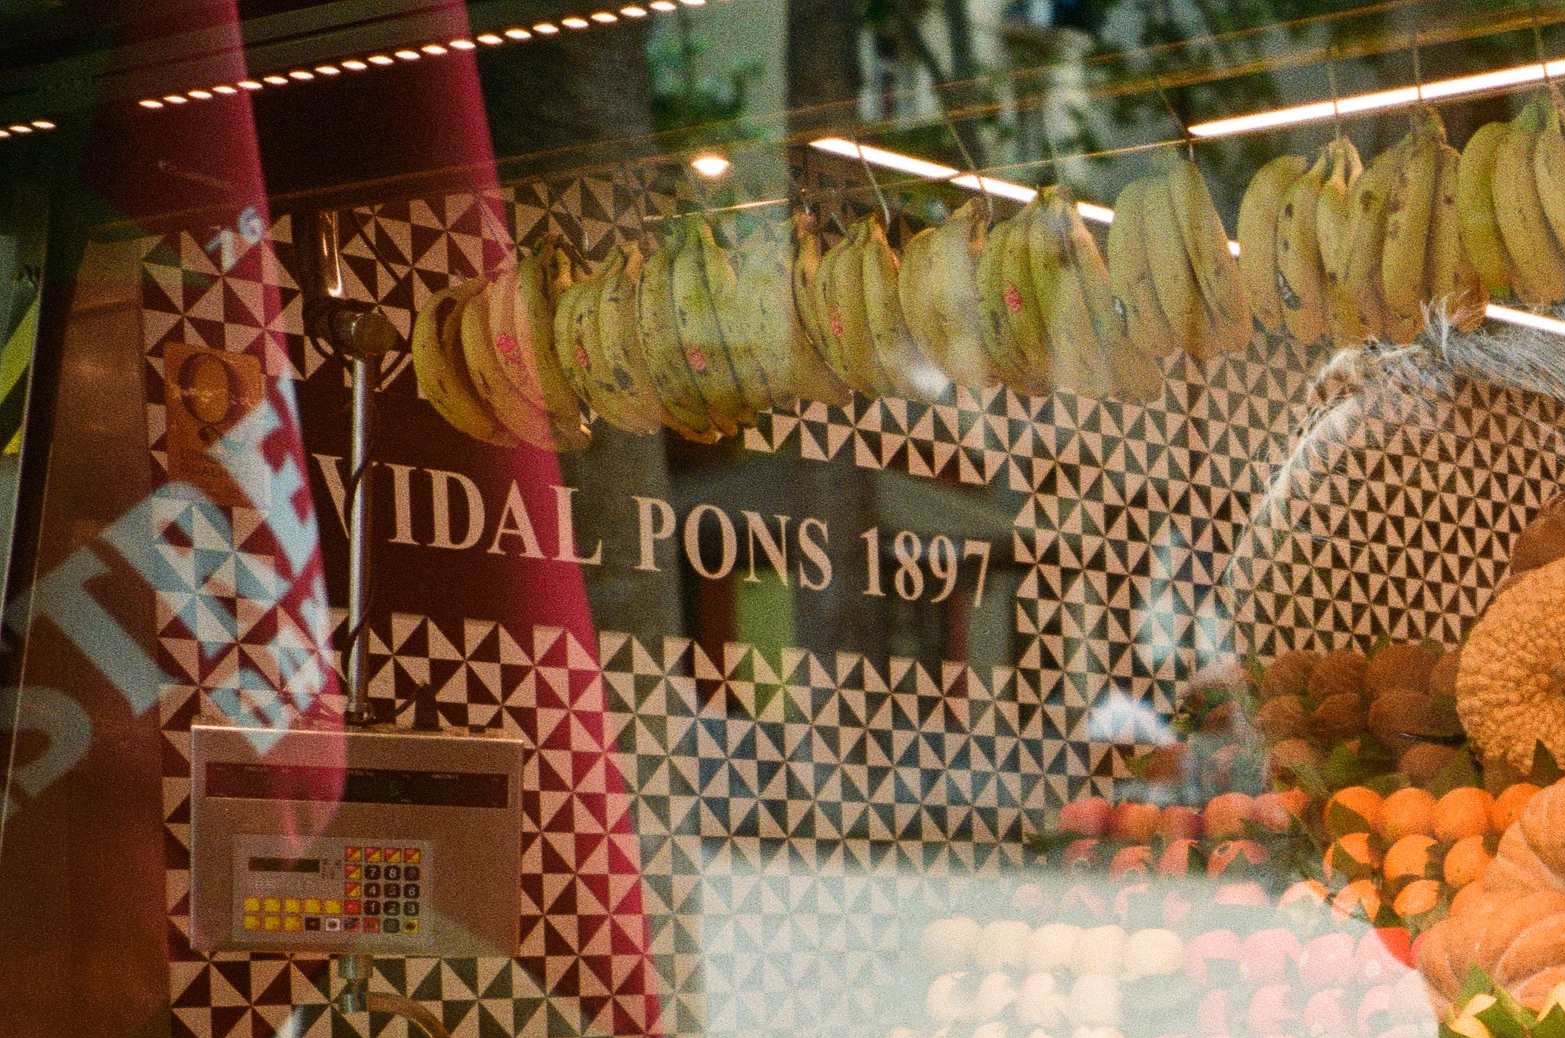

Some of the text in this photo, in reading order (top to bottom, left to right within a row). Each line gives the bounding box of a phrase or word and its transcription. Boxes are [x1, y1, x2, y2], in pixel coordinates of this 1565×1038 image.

[312, 453, 992, 608] VIDAL PONS 1897
